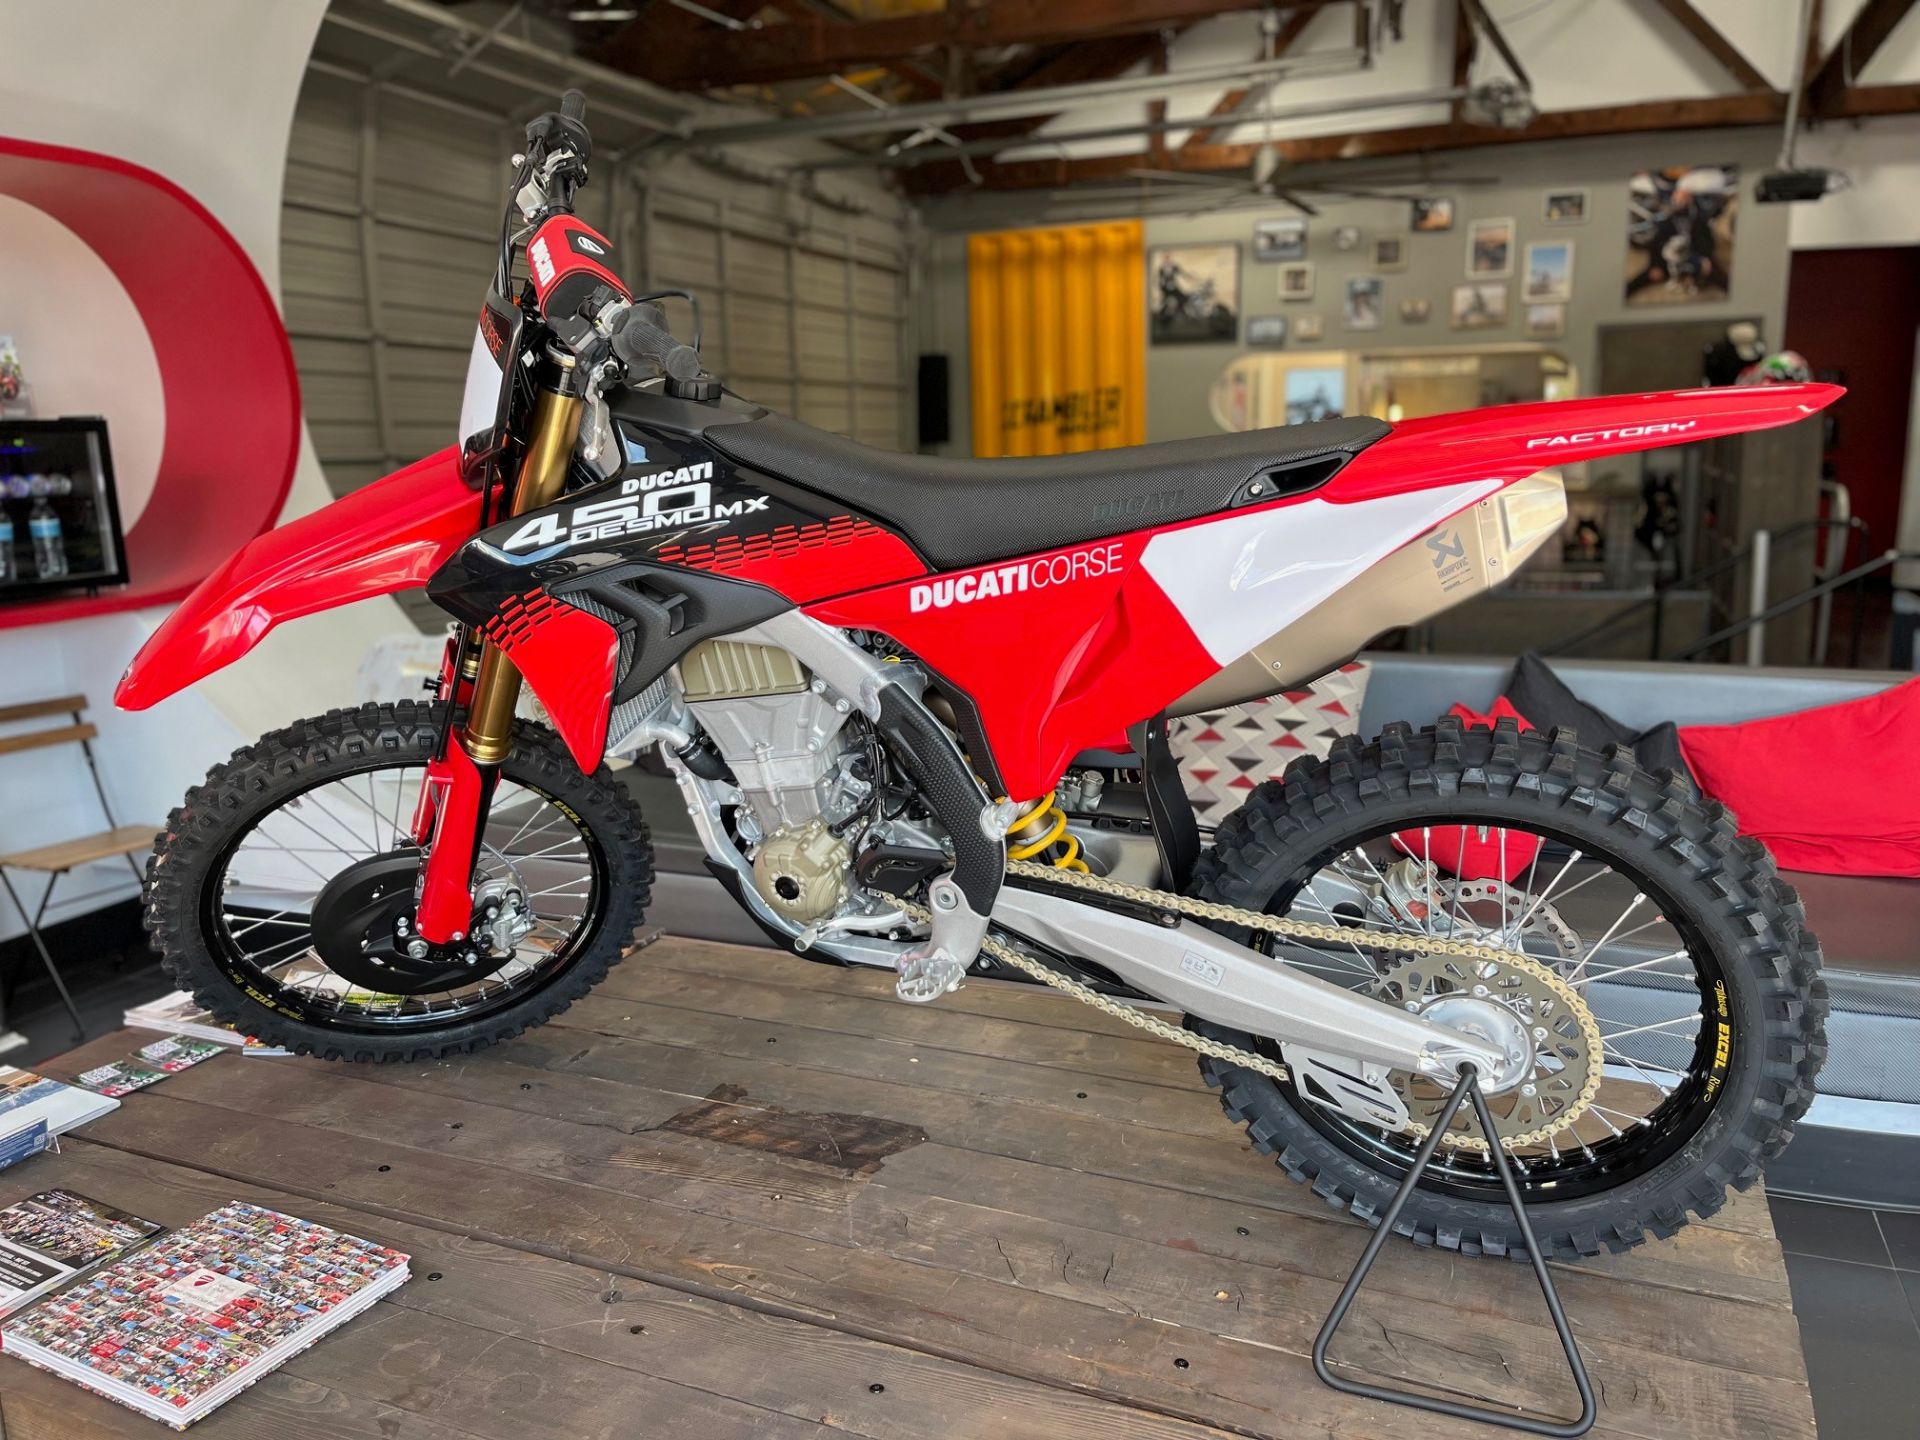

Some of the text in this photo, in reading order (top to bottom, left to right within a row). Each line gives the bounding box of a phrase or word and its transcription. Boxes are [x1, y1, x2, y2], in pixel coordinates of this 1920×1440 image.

[1526, 420, 1697, 449] FACTORY
[621, 462, 713, 495] DUCATI
[502, 482, 711, 551] 450
[570, 495, 770, 545] DESMO MX
[1714, 1022, 1730, 1068] EXCEL
